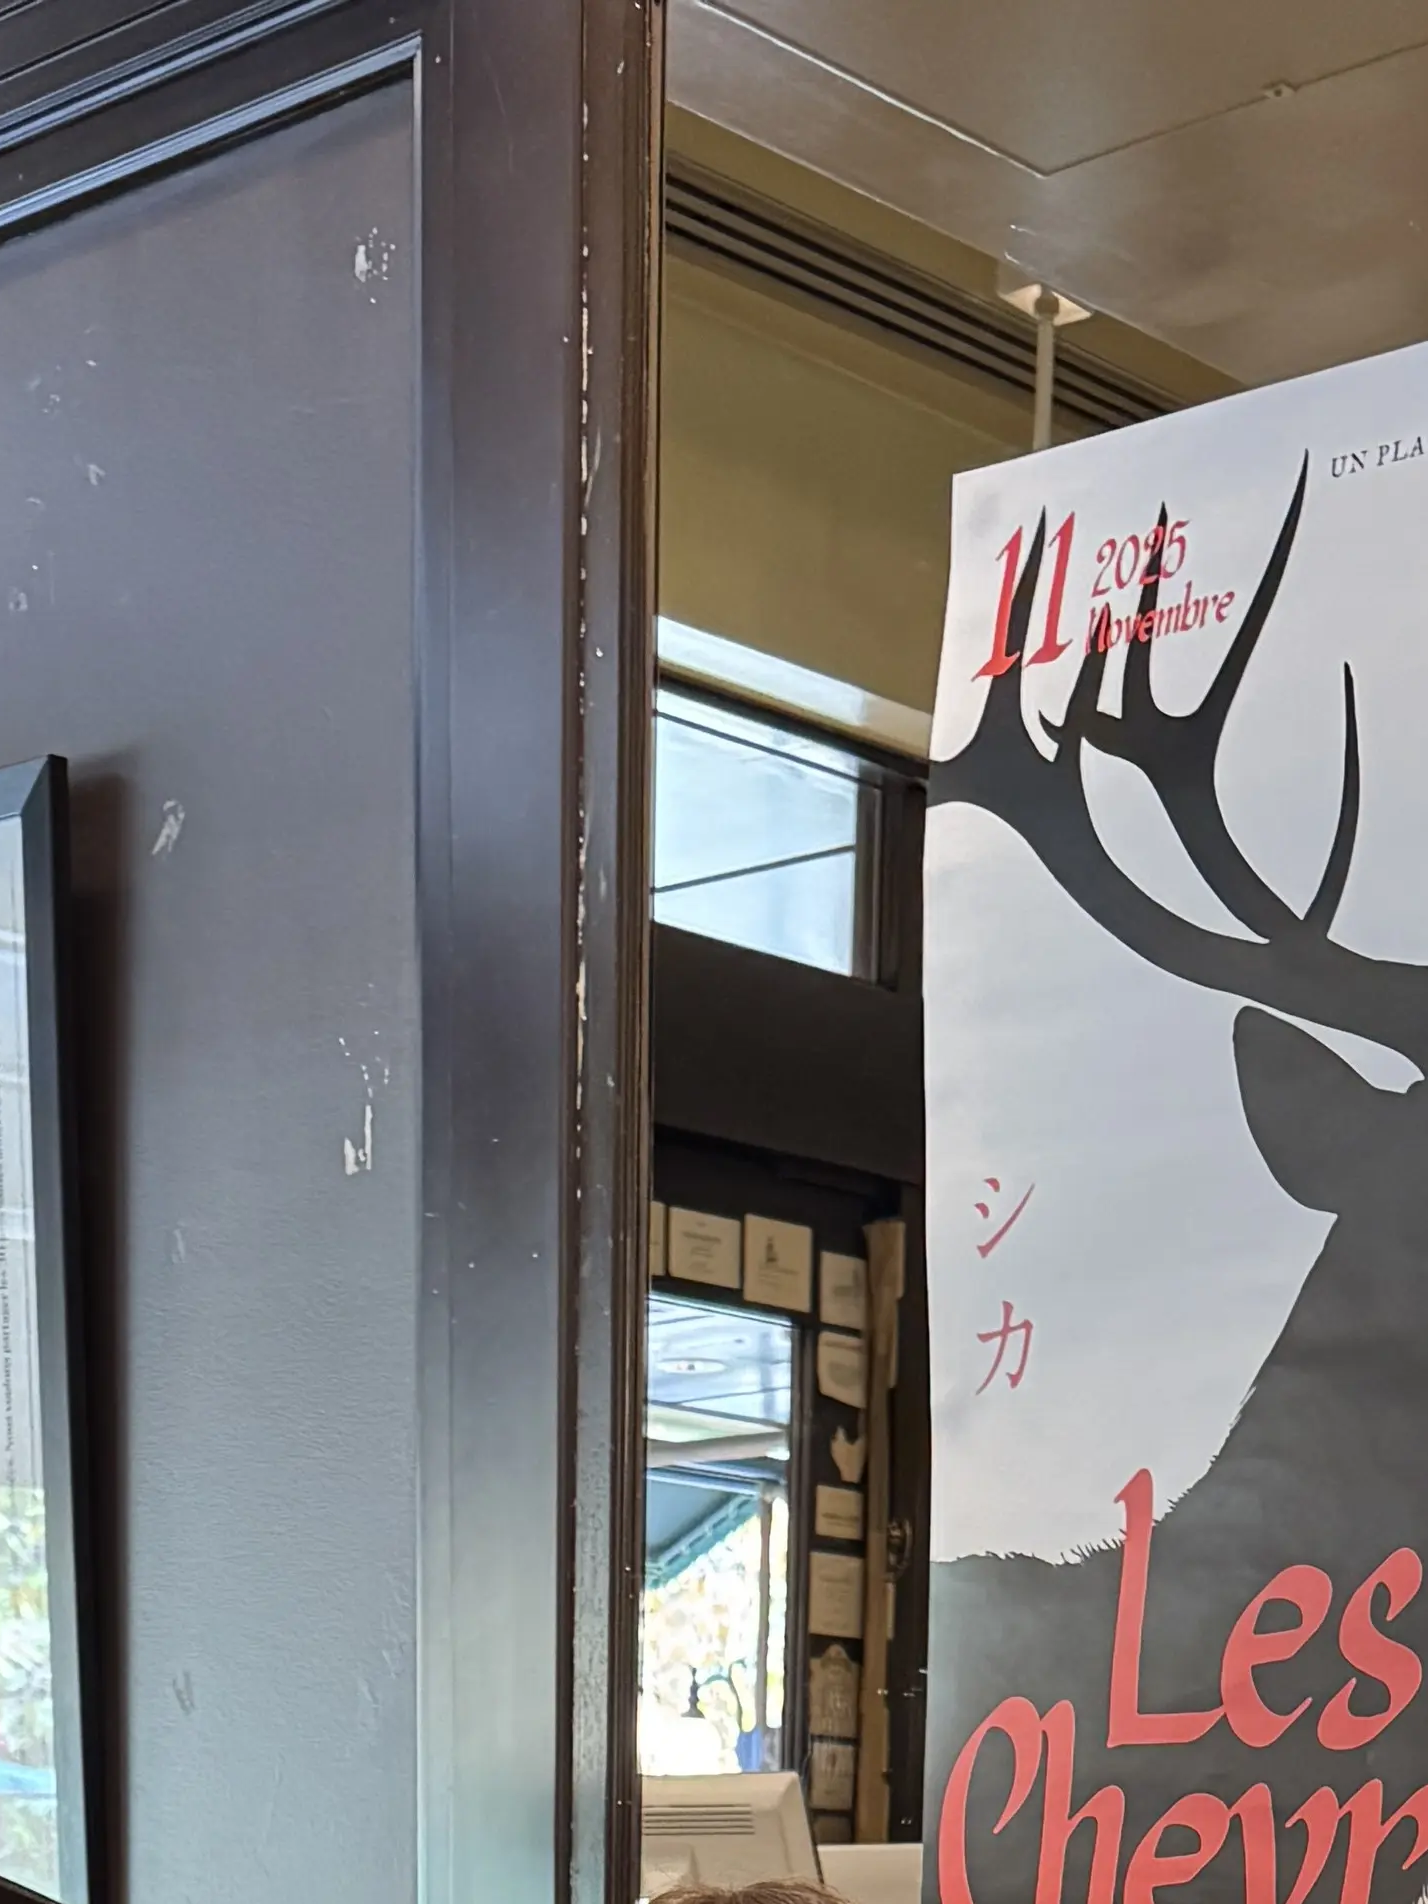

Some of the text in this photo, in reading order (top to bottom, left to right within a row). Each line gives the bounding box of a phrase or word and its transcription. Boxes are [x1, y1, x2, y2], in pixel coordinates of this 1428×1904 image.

[1330, 450, 1368, 478] UN
[970, 510, 1076, 682] 11
[1084, 579, 1236, 657] Novembre
[1090, 519, 1191, 598] 2025
[974, 1177, 1035, 1396] シカ
[1106, 1468, 1423, 1750] Les
